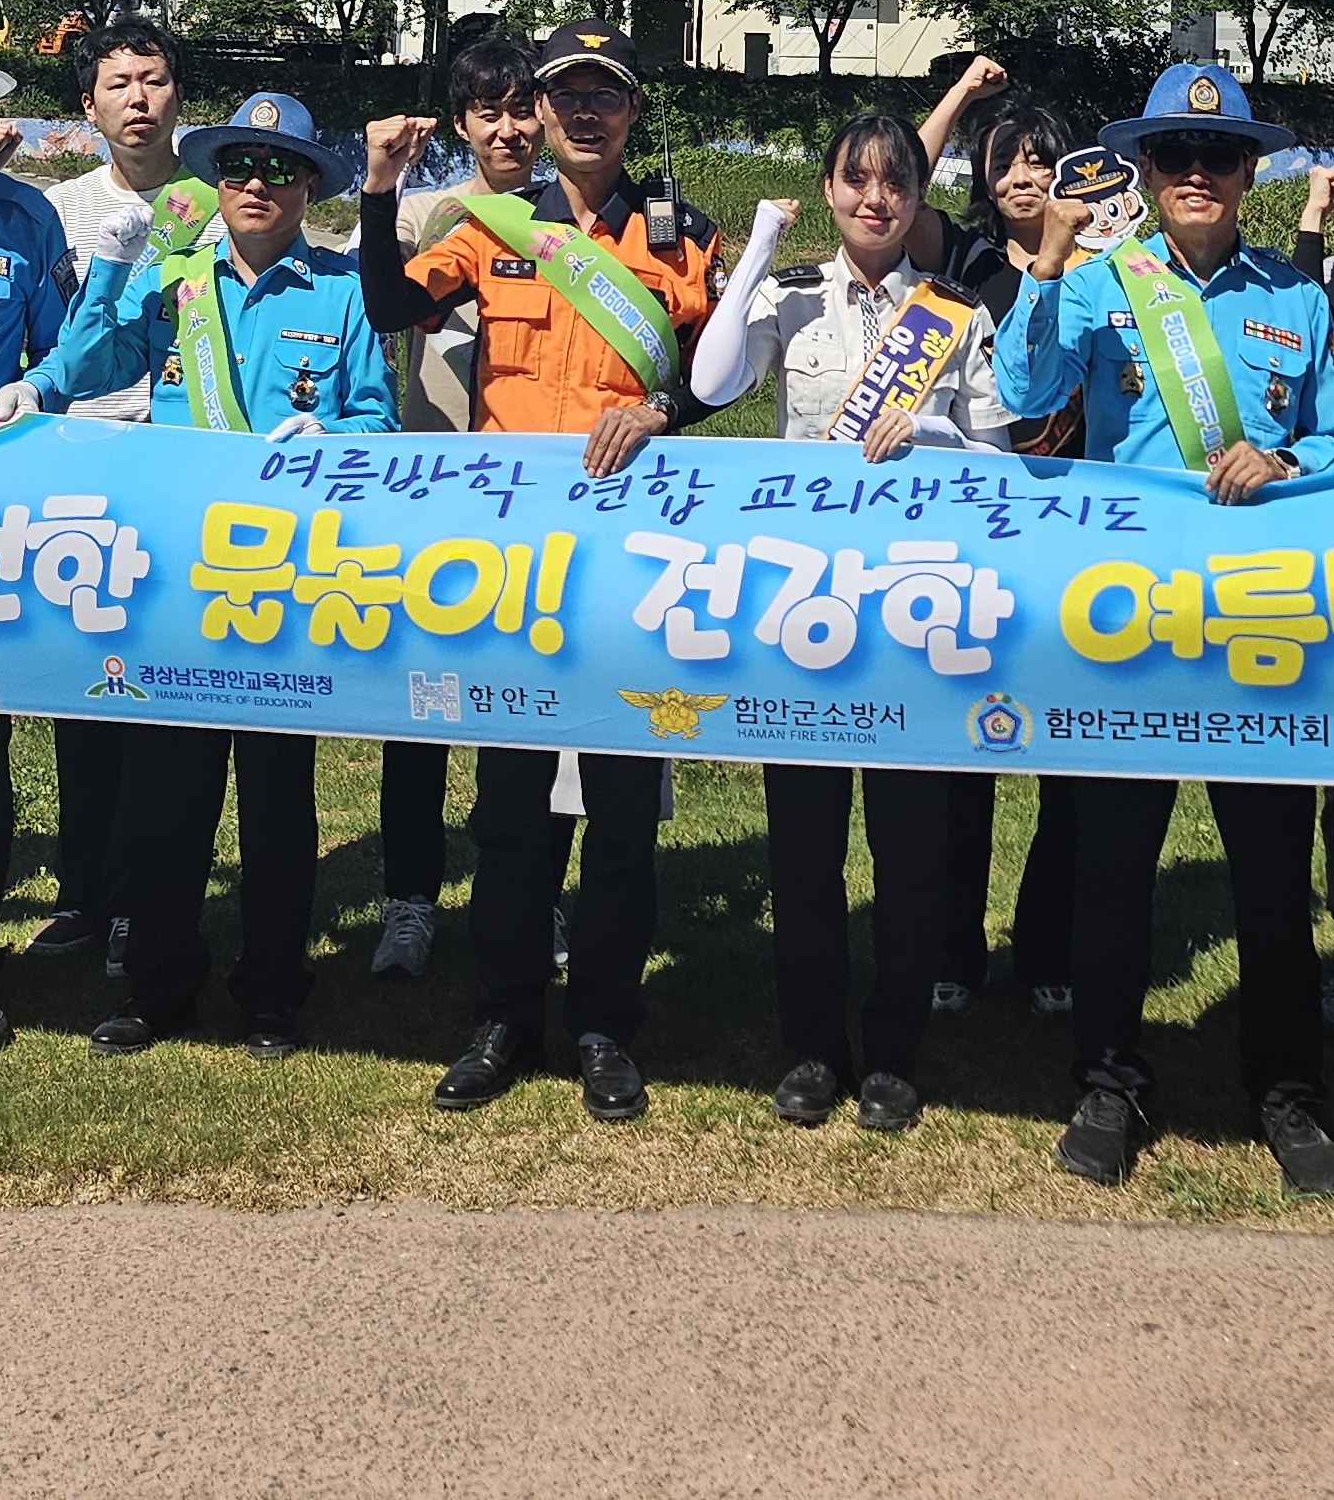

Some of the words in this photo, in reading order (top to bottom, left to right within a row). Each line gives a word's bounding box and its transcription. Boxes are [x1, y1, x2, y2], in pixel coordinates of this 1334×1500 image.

[587, 271, 644, 331] 생명을
[194, 333, 217, 396] 생명을
[1161, 312, 1203, 380] 생명을
[1184, 377, 1224, 451] 지키는
[259, 448, 537, 519] 여름방학
[568, 453, 715, 525] 연합
[740, 469, 1148, 539] 교외생활지도
[189, 501, 578, 655] 물놀이!
[624, 531, 1015, 676] 건강한
[139, 665, 333, 695] 경상남도함안교육지원청
[155, 690, 193, 702] HAMAN
[197, 693, 233, 705] OFFICE
[237, 696, 248, 705] OF
[254, 697, 312, 709] EDUCATION
[468, 685, 560, 716] 함안군
[734, 696, 906, 731] 함안군소방서
[738, 728, 786, 740] HAMAN
[791, 731, 817, 742] FIRE
[822, 731, 877, 744] STATION
[1045, 708, 1329, 746] 함안군모범운전자회
